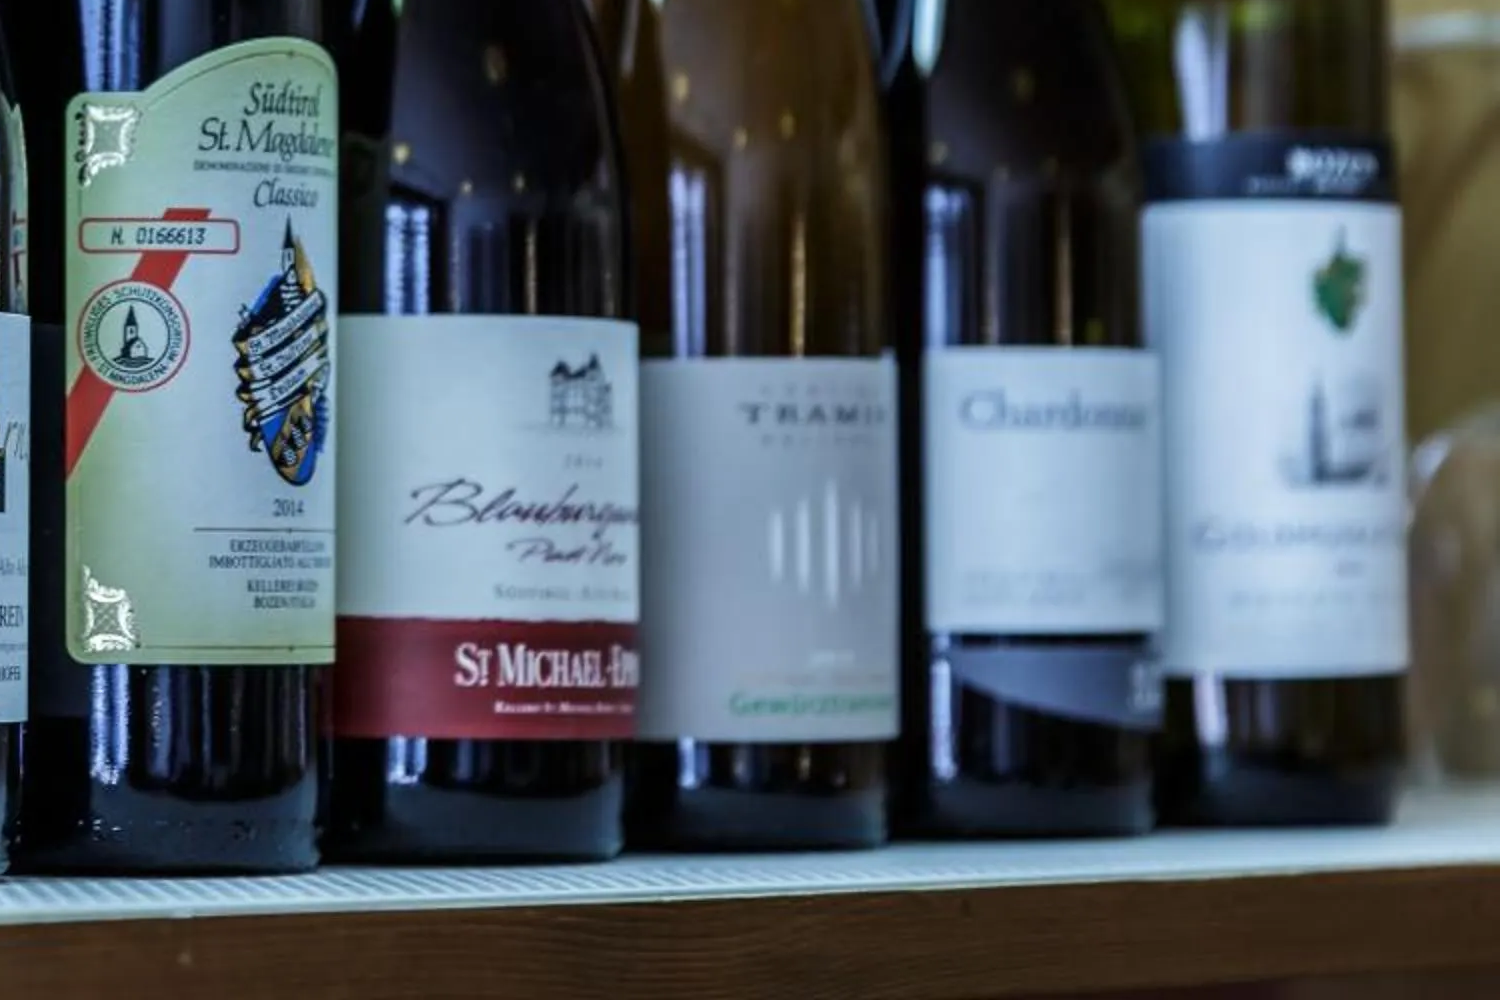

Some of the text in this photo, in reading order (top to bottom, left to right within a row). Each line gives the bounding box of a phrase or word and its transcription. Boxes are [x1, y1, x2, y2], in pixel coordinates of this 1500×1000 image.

[244, 79, 323, 117] Südtirol
[198, 117, 232, 151] St.
[253, 177, 319, 207] Classico
[136, 227, 206, 245] 0166613
[273, 498, 305, 517] 2014
